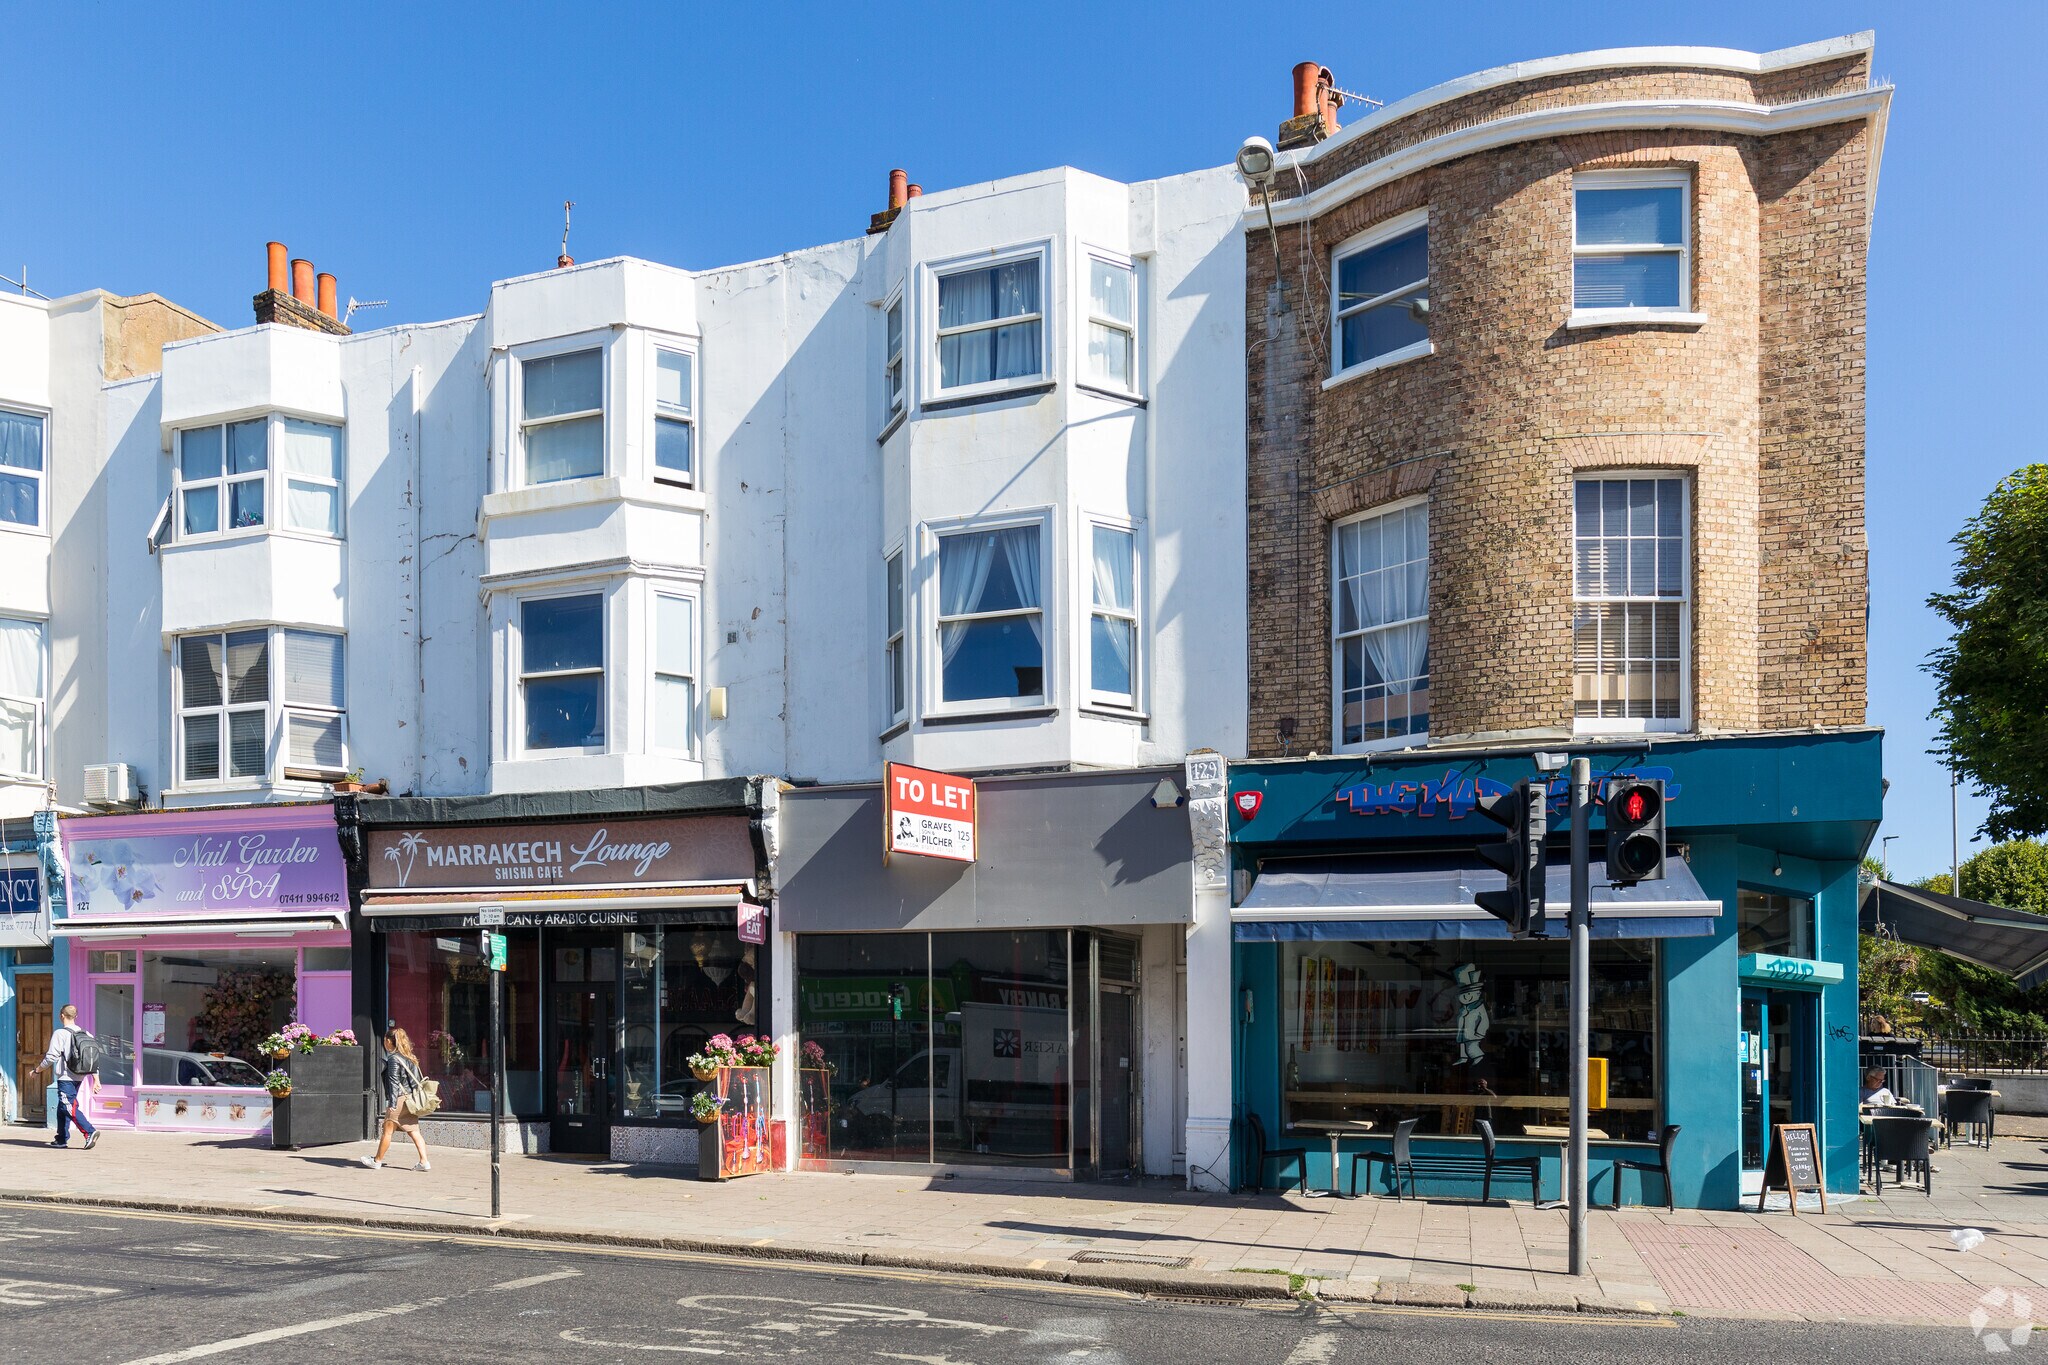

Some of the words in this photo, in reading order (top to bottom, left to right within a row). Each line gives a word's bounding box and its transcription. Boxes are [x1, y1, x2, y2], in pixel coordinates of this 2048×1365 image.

[1191, 761, 1217, 780] 129
[896, 776, 925, 803] TO
[931, 783, 971, 811] LET
[921, 819, 952, 833] GRAVES
[921, 835, 953, 848] PILCHER
[957, 830, 970, 842] 125
[173, 837, 229, 868] Nail
[236, 834, 319, 875] Garden
[427, 841, 563, 867] MARRAKECH
[570, 828, 672, 877] Lounge
[495, 866, 535, 880] SHISHA
[537, 865, 564, 879] CAFE
[176, 882, 206, 902] and
[211, 872, 282, 901] SPA
[279, 893, 304, 904] 07411
[306, 892, 340, 903] 994612
[76, 902, 90, 911] 127
[463, 913, 533, 927] MOCAN
[535, 913, 543, 926] &
[545, 912, 588, 926] ARABIC
[590, 911, 638, 925] CUISINE
[741, 907, 761, 921] JUST
[0, 921, 14, 931] Fax
[15, 920, 42, 930] 77721
[746, 921, 761, 935] EAT
